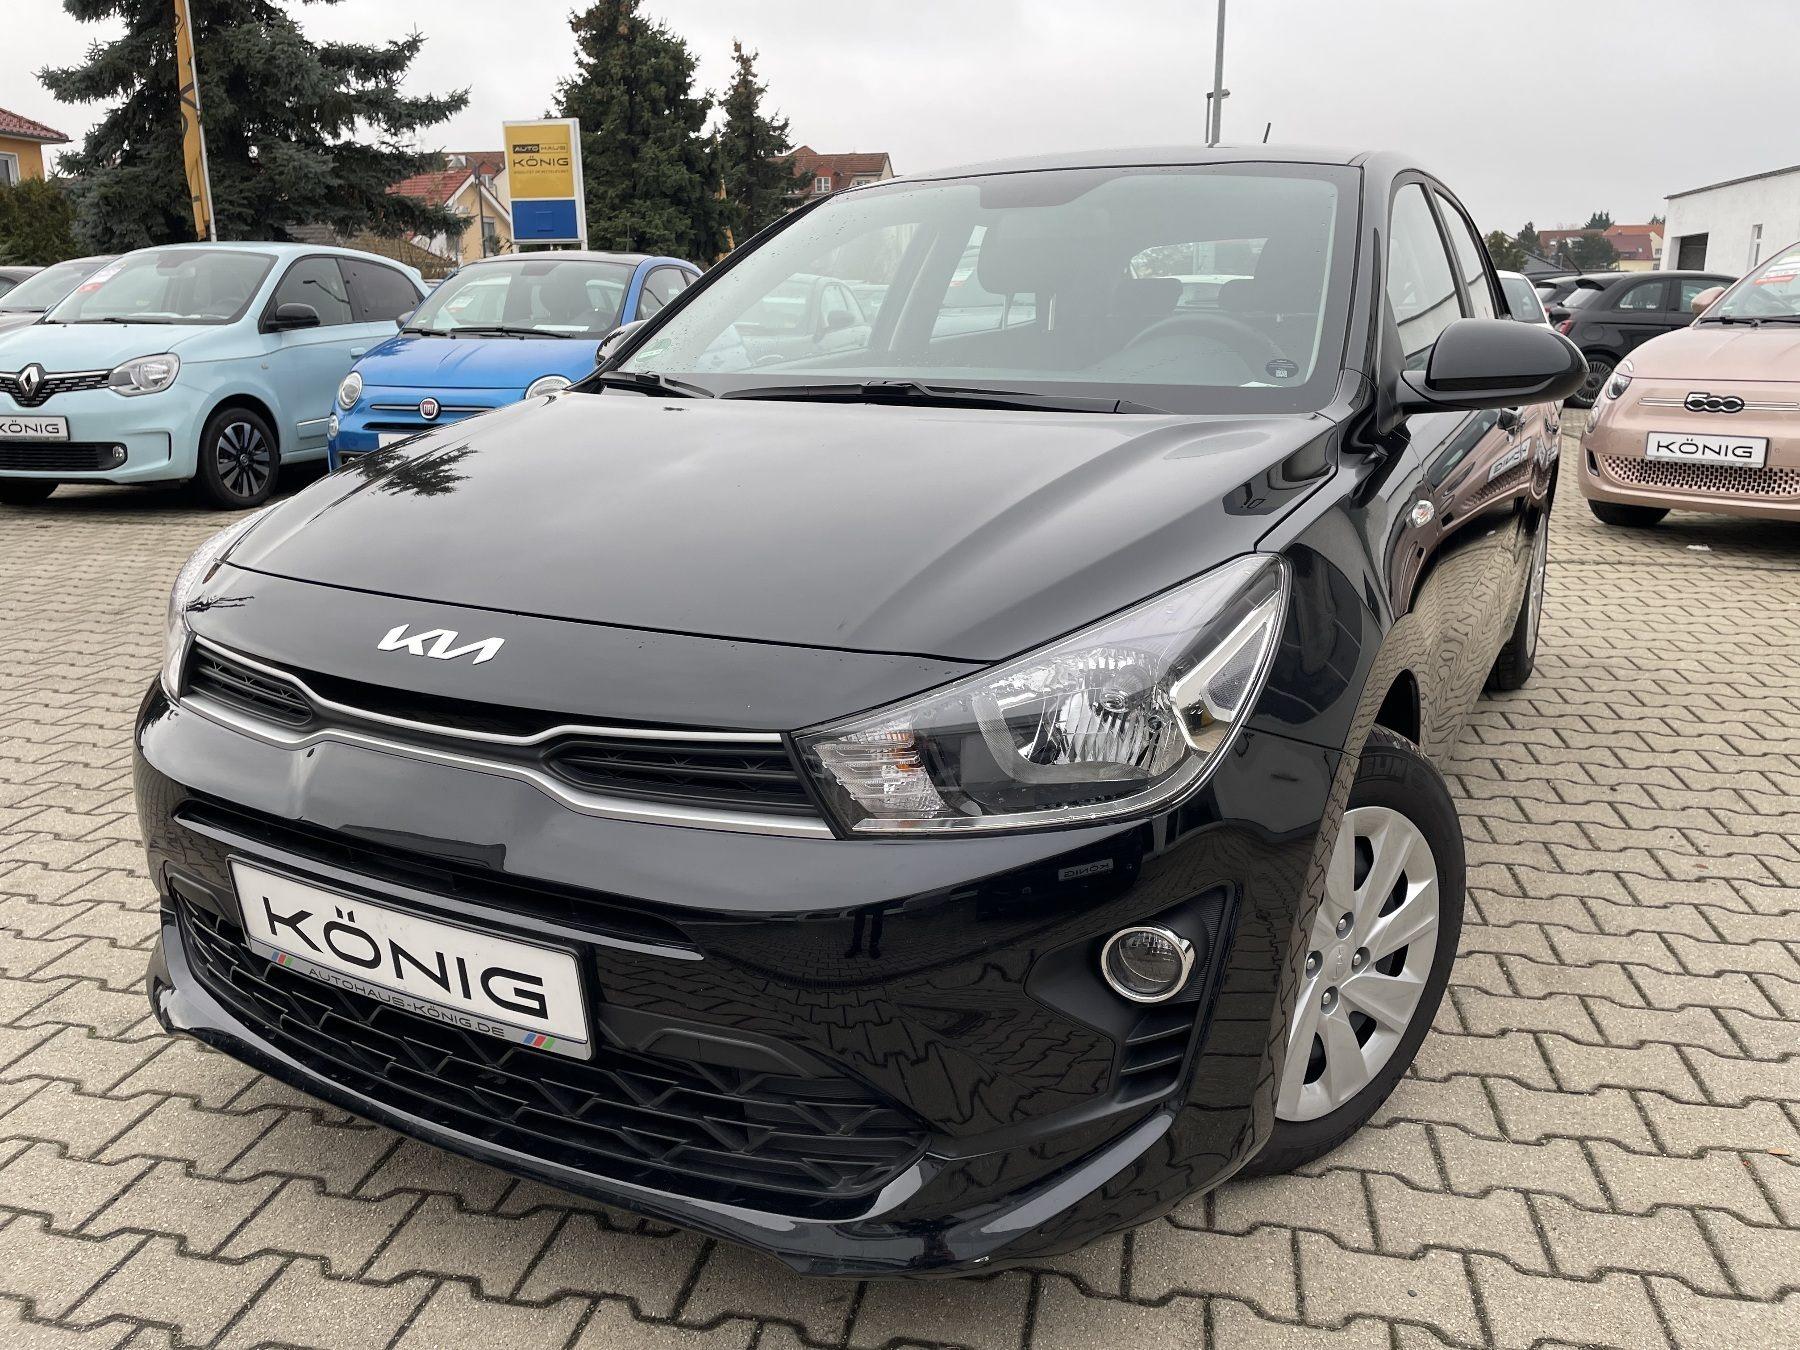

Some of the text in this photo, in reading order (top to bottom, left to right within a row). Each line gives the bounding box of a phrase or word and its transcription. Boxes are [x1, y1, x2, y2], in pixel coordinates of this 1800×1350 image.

[513, 155, 569, 167] KÖNIG
[1685, 392, 1744, 413] 500
[1656, 438, 1753, 459] KÖNIG
[262, 895, 550, 1020] KÖNIG
[308, 967, 505, 1038] AUTOHAUS-KÖNIG.DE
